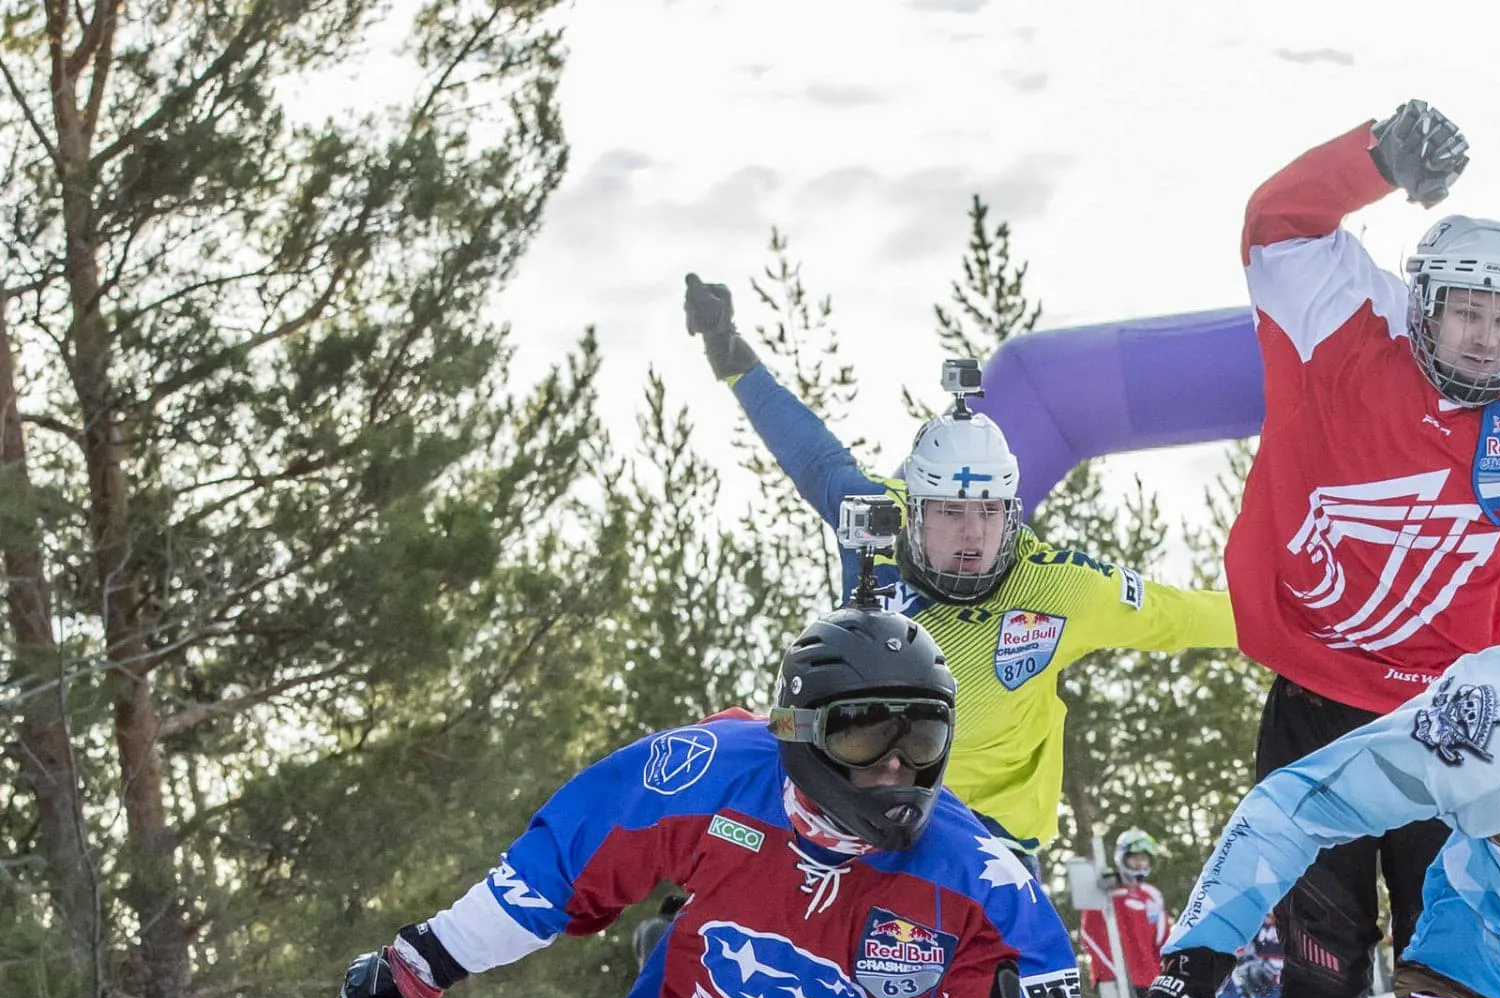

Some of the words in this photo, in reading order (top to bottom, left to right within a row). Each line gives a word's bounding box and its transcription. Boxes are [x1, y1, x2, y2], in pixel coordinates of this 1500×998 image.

[1004, 630, 1030, 645] Red
[1032, 626, 1056, 640] Bull
[1003, 656, 1036, 682] 870
[1383, 668, 1421, 683] Just
[711, 818, 760, 847] KCCO
[865, 939, 905, 961] Red
[905, 943, 944, 964] Bull
[882, 978, 918, 996] 63
